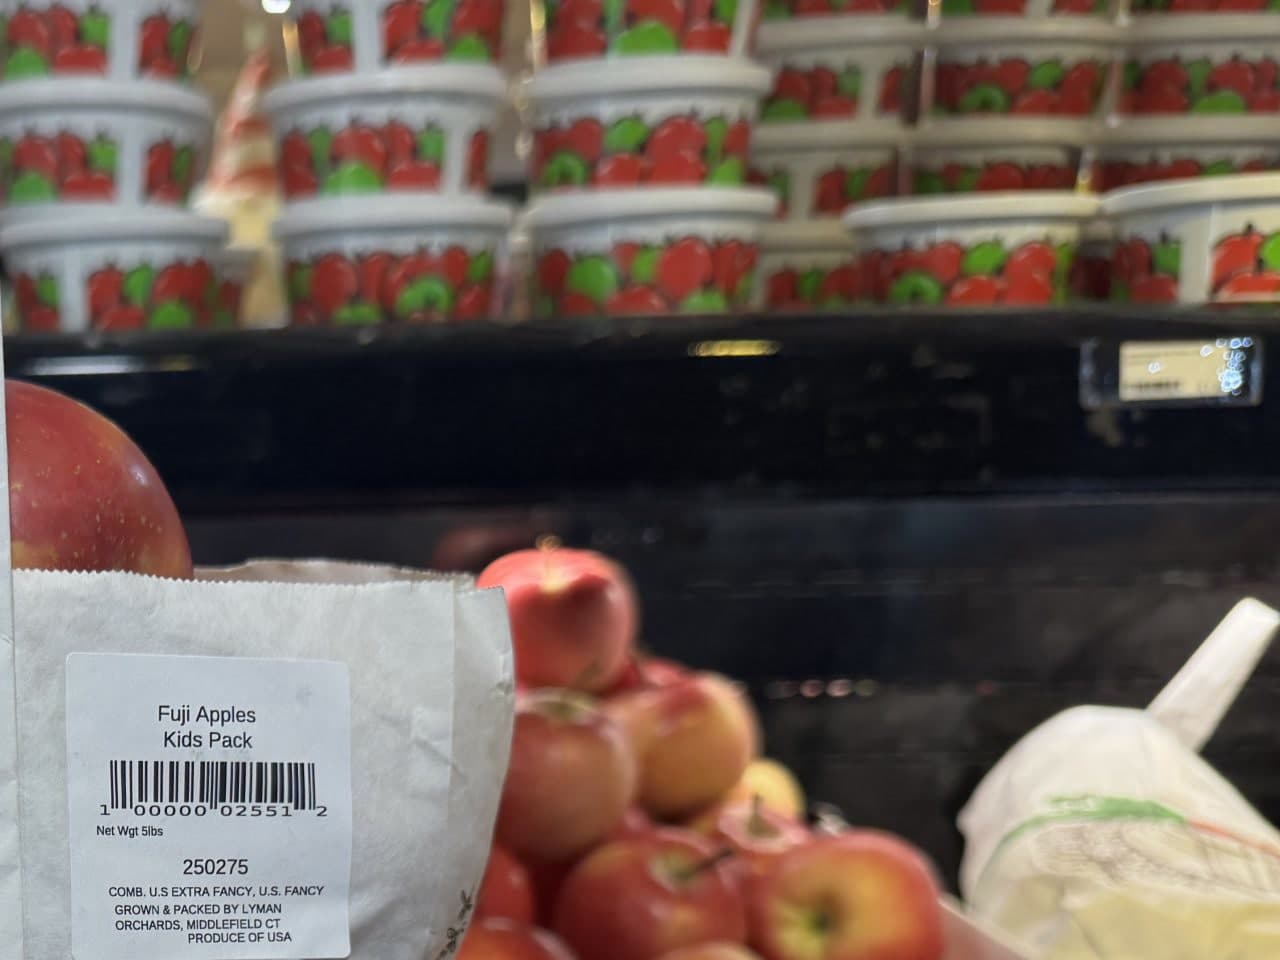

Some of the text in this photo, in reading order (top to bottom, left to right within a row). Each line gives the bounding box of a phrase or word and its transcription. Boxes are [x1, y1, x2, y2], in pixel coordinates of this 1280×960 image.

[158, 705, 257, 727] Fuji Apples
[163, 731, 253, 749] Kids Pack
[99, 804, 328, 817] 1 00000 02551 2
[96, 825, 164, 839] Net Wgt 5lbs
[182, 858, 249, 876] 250275
[108, 886, 146, 898] COMB.
[171, 886, 210, 897] EXTRA
[213, 886, 256, 898] FANCY,
[258, 885, 281, 897] U.S.
[284, 885, 325, 896] FANCY
[114, 903, 282, 915] GROWN & PACKED BY LYMAN
[115, 918, 281, 932] ORCHARDS, MIDDLEFIELD CT
[187, 931, 292, 944] PRODUCE OF USA
